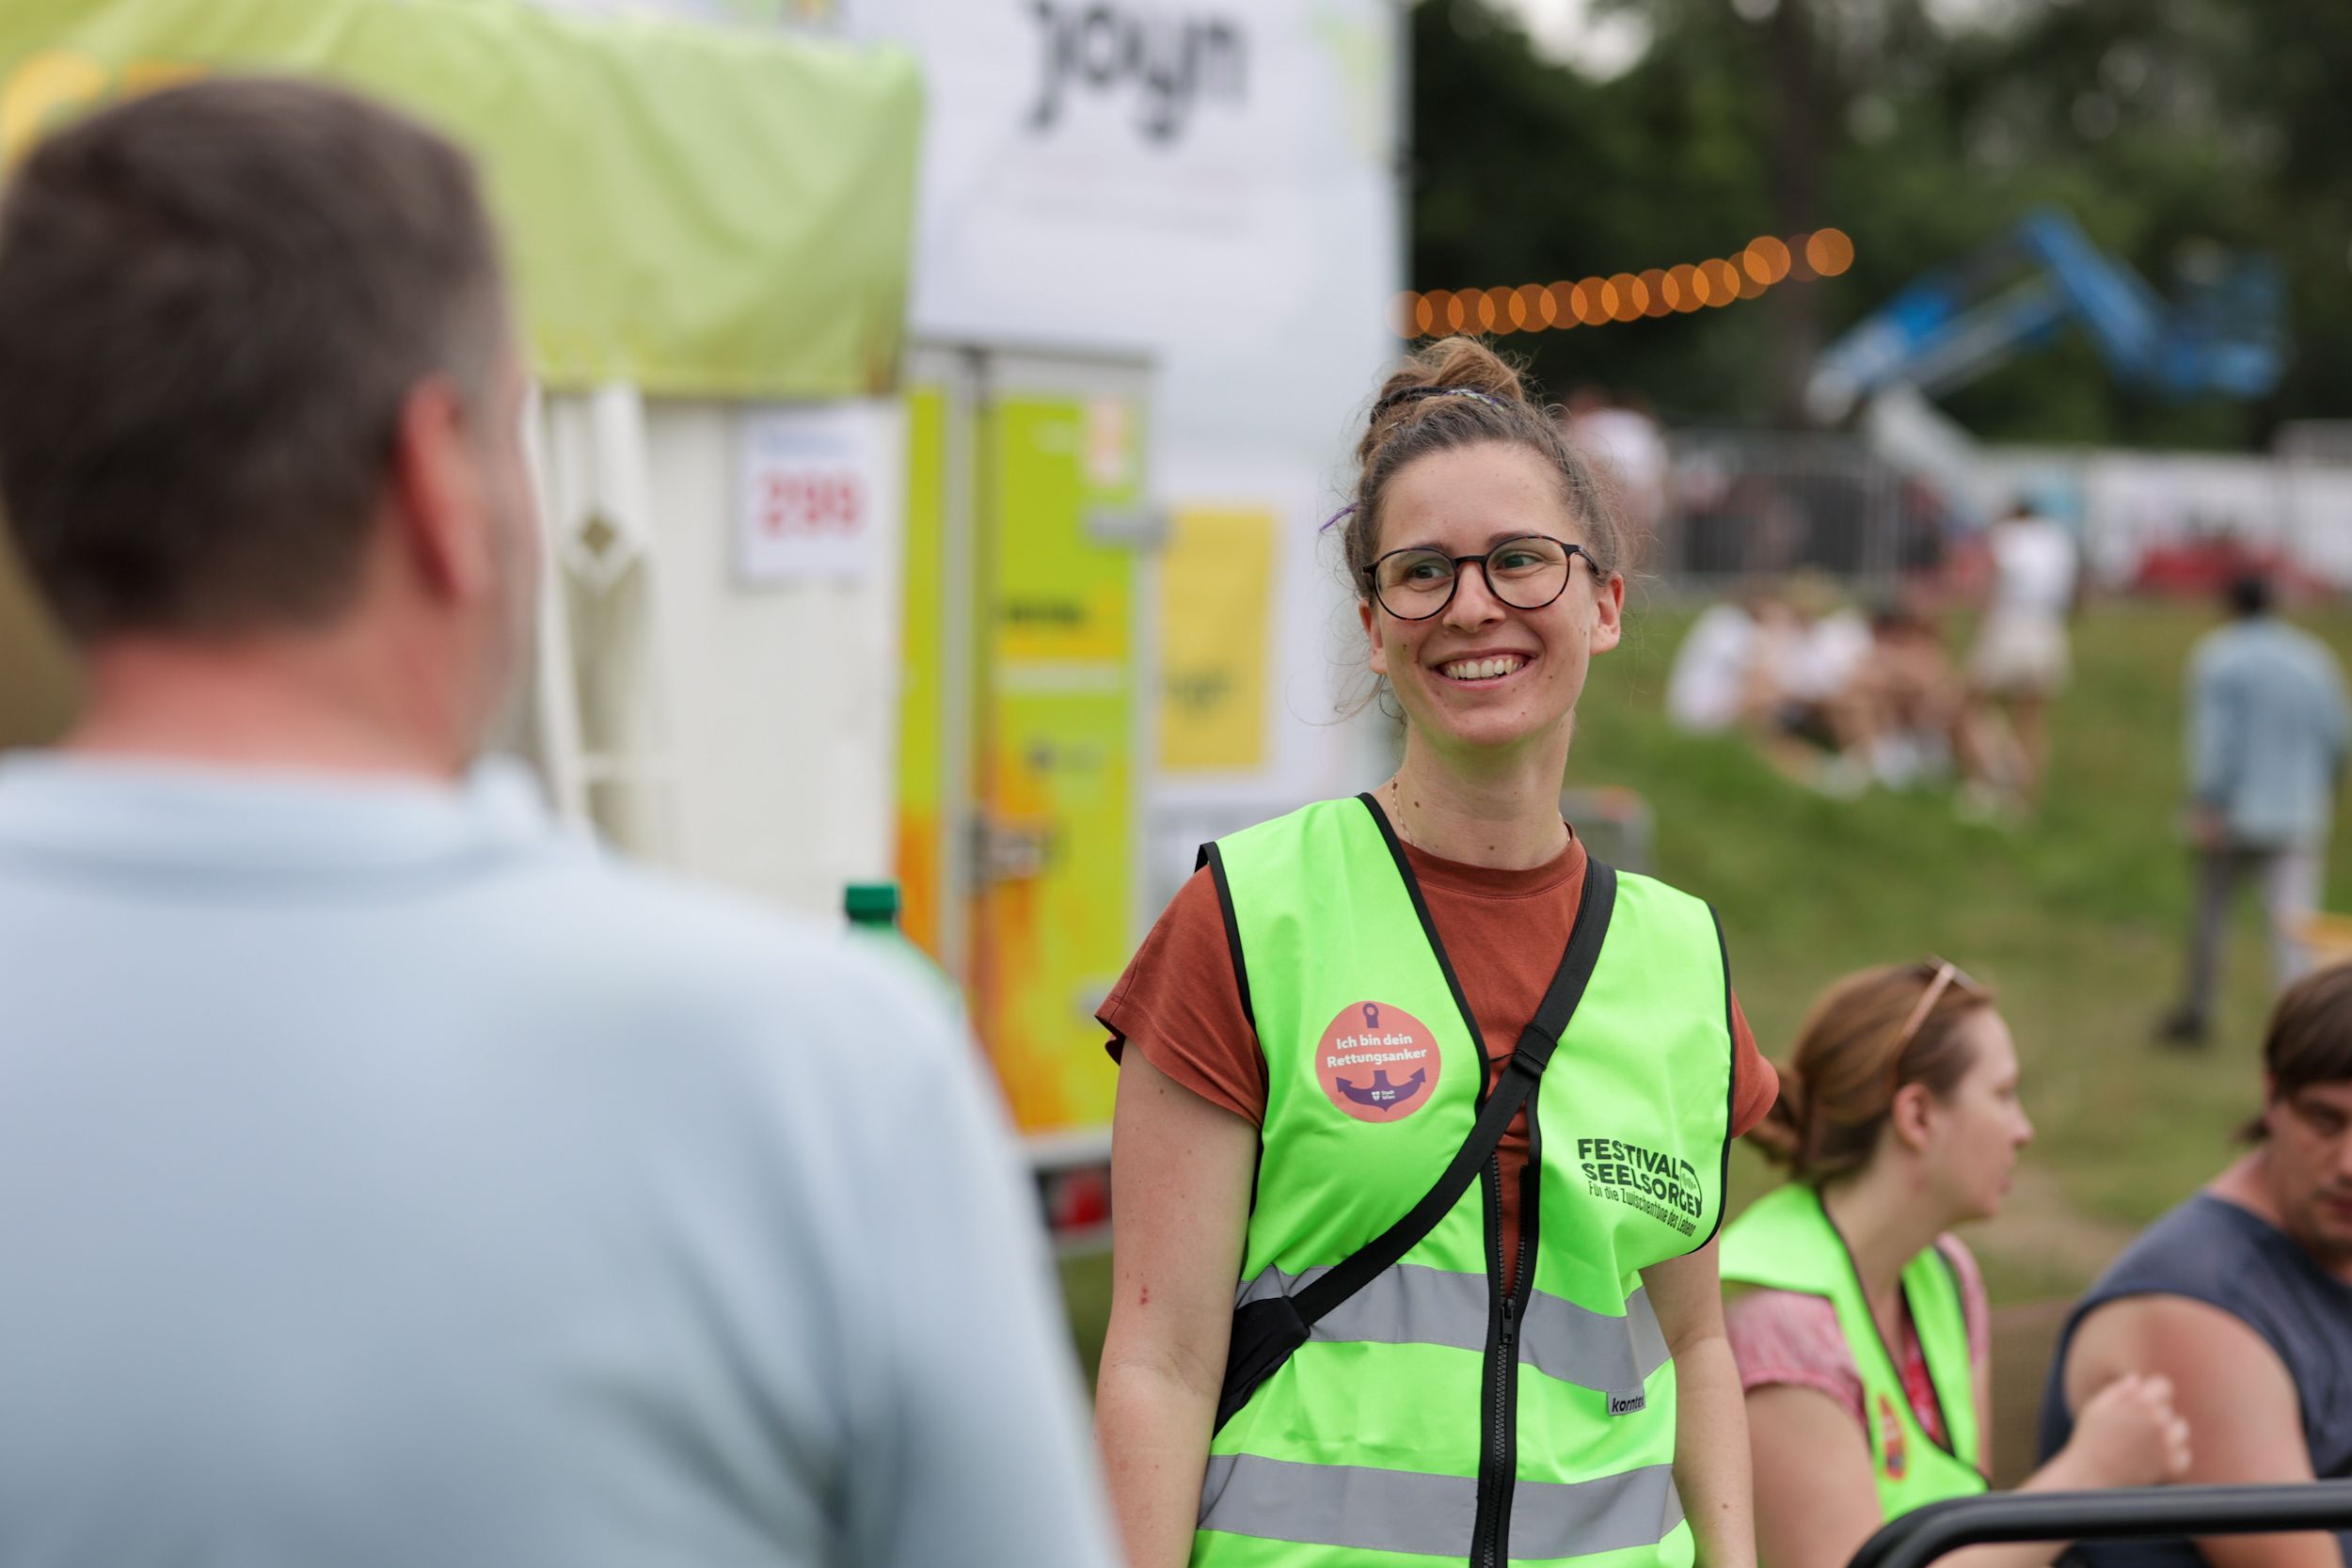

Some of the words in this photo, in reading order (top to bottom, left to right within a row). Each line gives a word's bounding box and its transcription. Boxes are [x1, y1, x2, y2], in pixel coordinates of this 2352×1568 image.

[1336, 1037, 1358, 1050] Ich
[1359, 1035, 1381, 1047] bin
[1383, 1034, 1413, 1046] dein
[1327, 1049, 1427, 1068] Rettungsanker
[1578, 1138, 1679, 1181] FESTIVAL
[1604, 1184, 1619, 1202] die
[1620, 1187, 1669, 1223] Zwischentöne
[1666, 1209, 1679, 1229] des
[1677, 1213, 1697, 1238] Lebens
